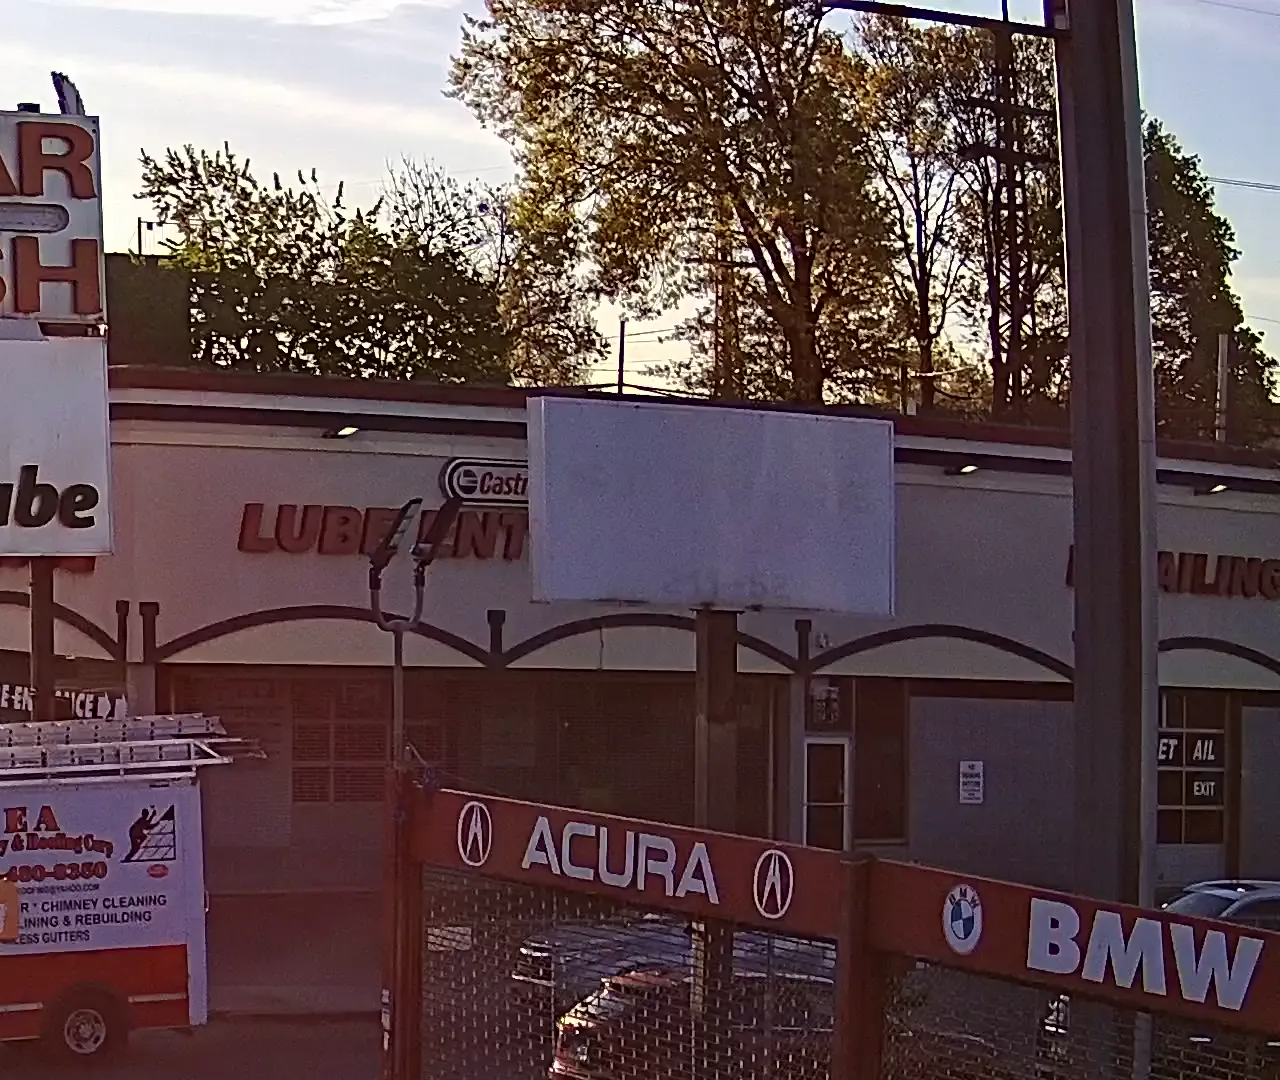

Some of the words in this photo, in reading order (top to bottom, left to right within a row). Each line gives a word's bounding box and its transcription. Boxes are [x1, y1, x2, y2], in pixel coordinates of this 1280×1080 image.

[479, 470, 528, 496] Castr
[237, 503, 394, 557] LUBE
[1193, 780, 1217, 797] EXIT
[521, 815, 721, 905] ACURA
[40, 898, 99, 912] CHIMNEY
[102, 894, 167, 910] CLEANING
[63, 915, 72, 927] &
[75, 911, 152, 926] REBUILDING
[41, 930, 90, 944] GUTTERS
[1027, 896, 1264, 1010] BMW
